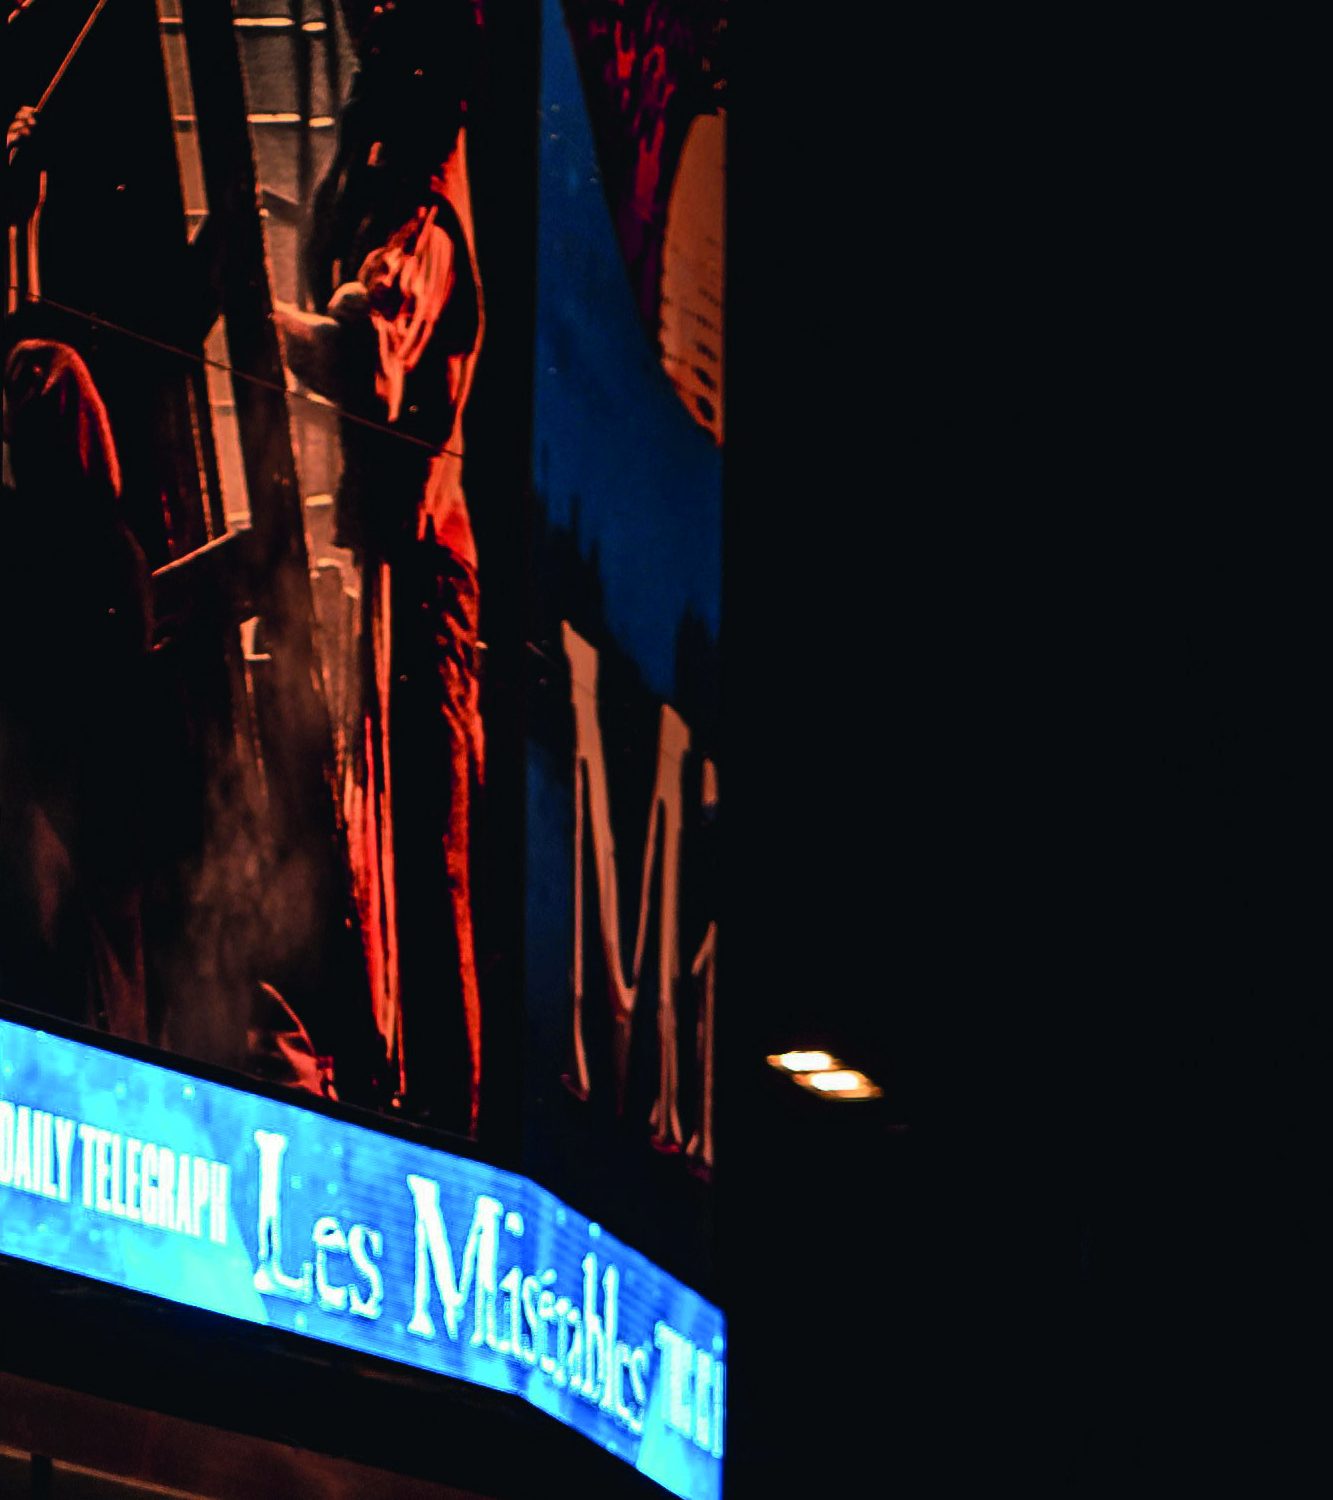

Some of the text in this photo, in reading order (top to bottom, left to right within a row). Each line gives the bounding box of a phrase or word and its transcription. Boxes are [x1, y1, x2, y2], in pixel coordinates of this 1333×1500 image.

[78, 1122, 230, 1246] TELEGRAPH
[254, 1130, 383, 1320] Les
[406, 1173, 651, 1434] Misérables
